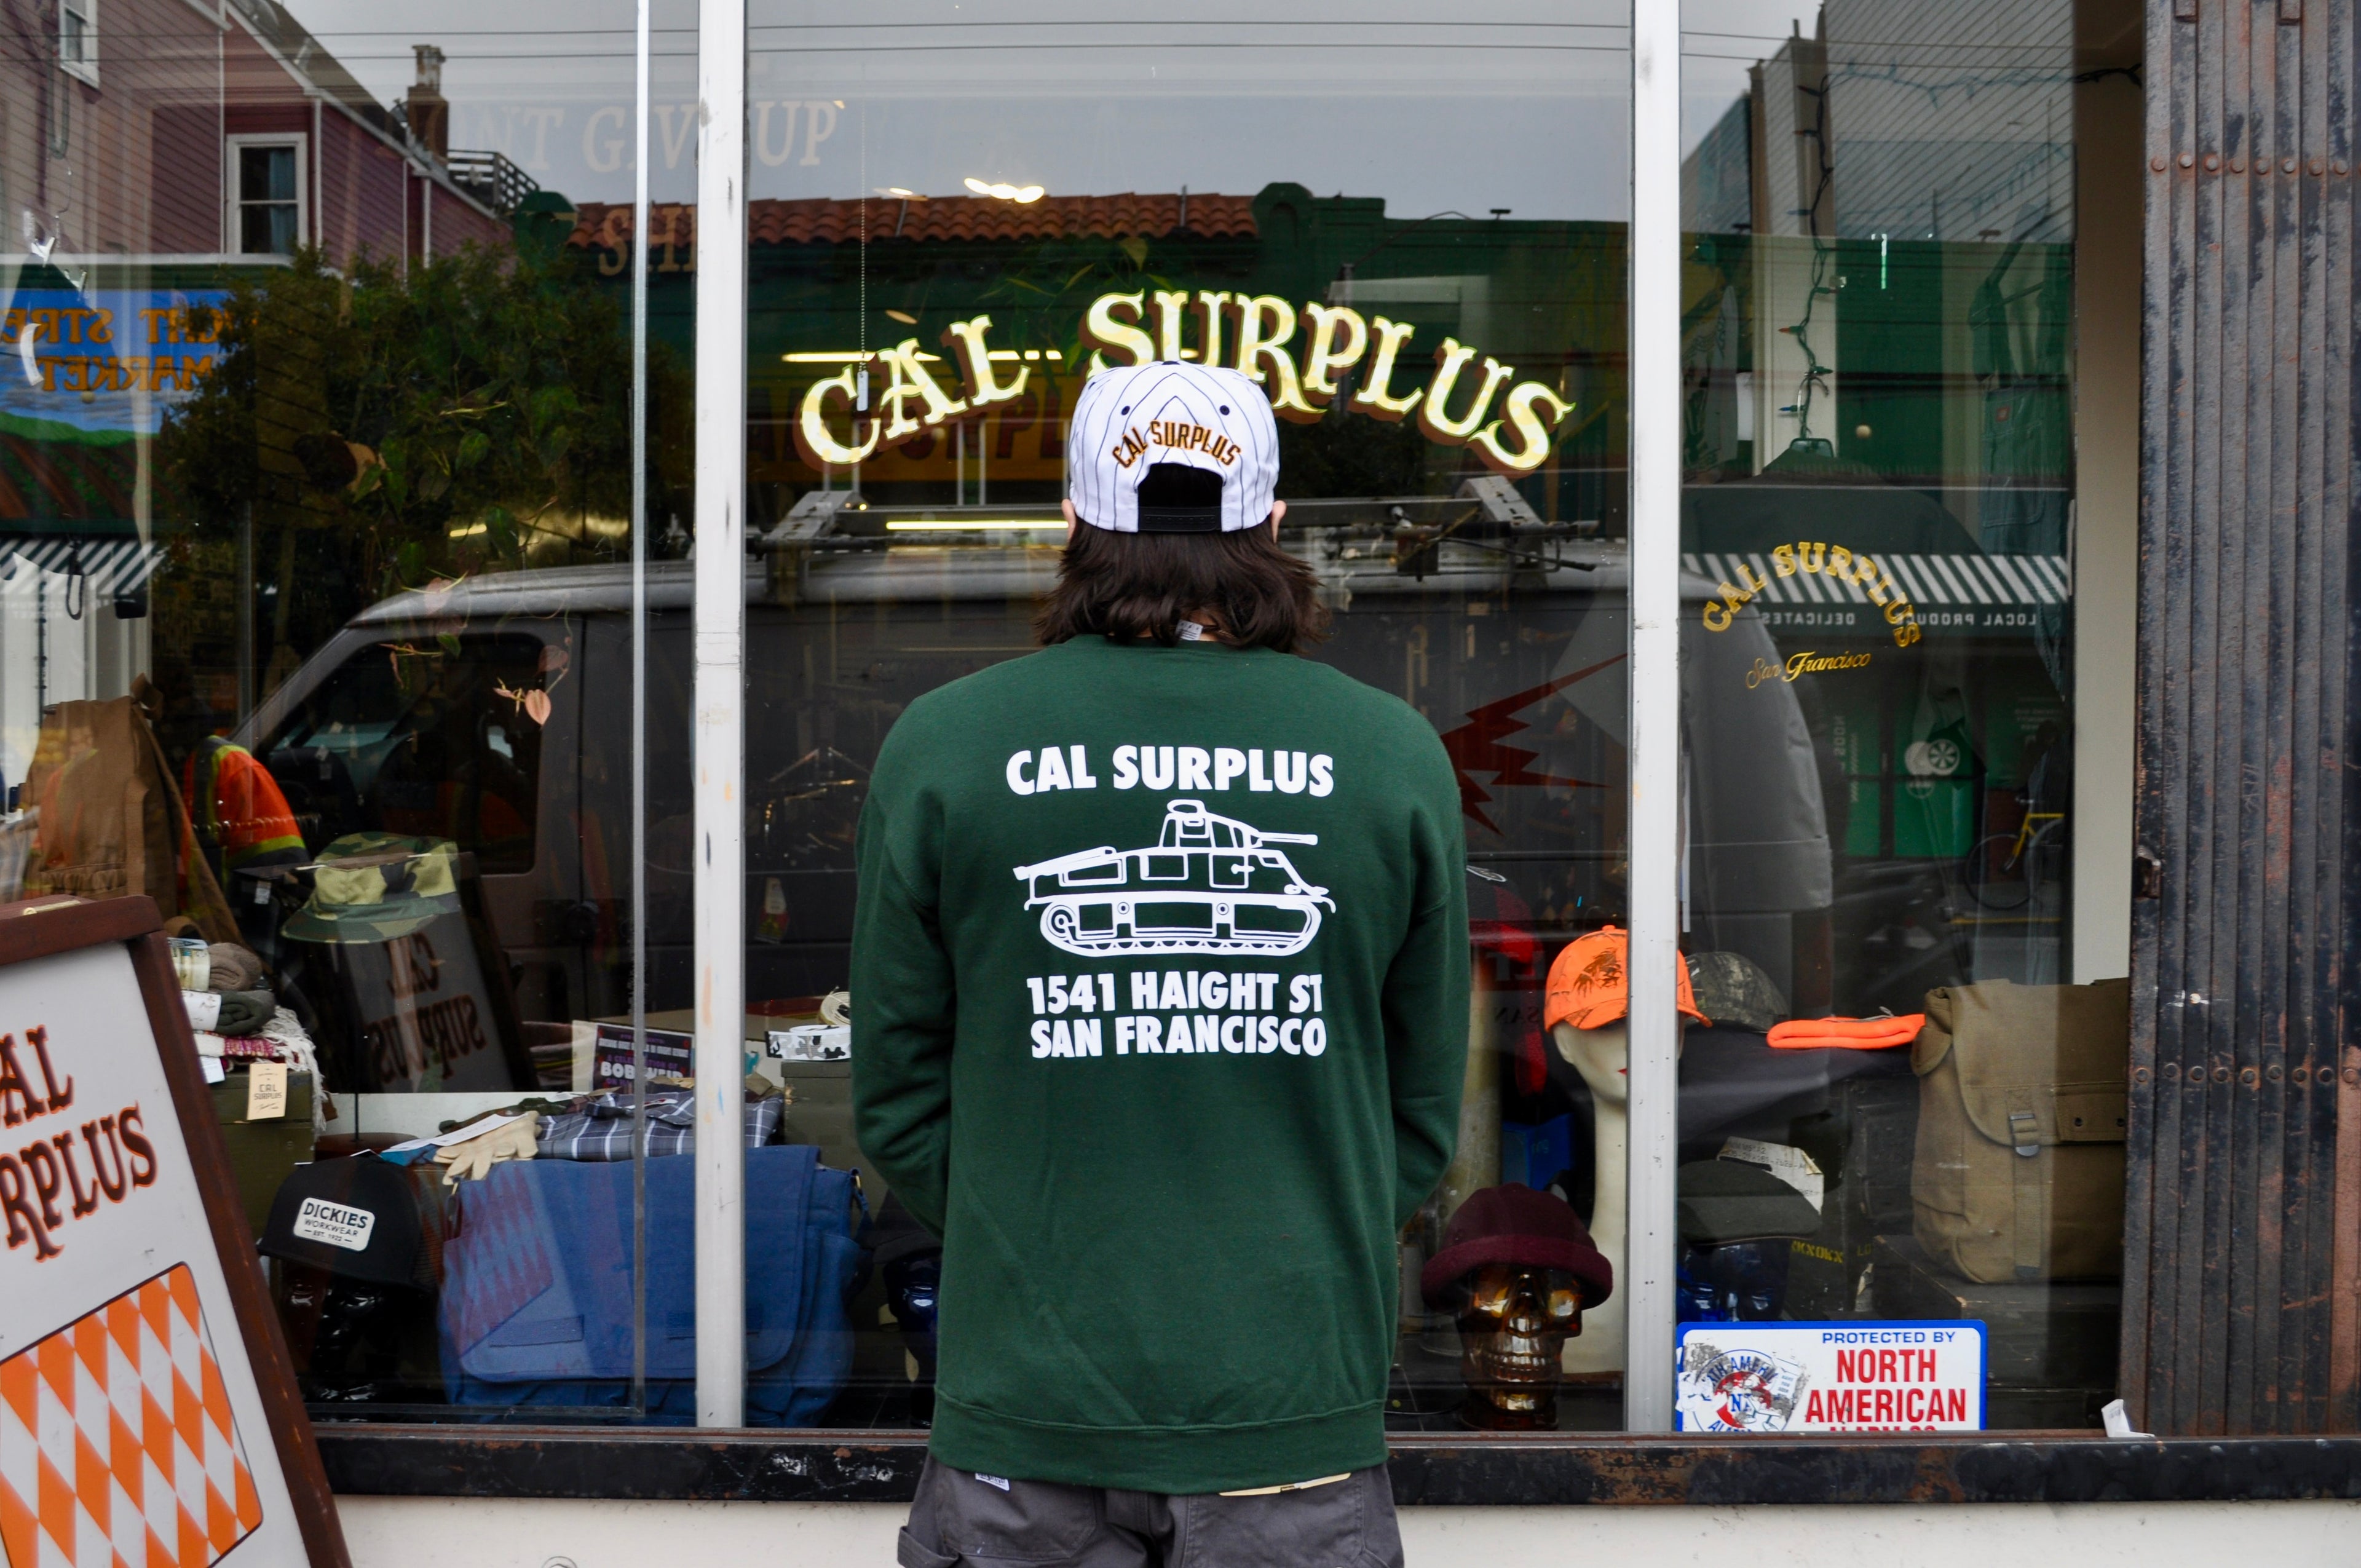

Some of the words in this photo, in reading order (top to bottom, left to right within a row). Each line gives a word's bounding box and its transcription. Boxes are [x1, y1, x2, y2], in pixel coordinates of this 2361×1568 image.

[756, 100, 837, 167] UP
[798, 314, 1030, 470] CAL
[1083, 289, 1576, 473] SURPLUS
[1112, 427, 1148, 469] CAL
[1150, 420, 1242, 466] SURPLUS
[1702, 564, 1768, 632] CAL
[1773, 542, 1921, 647] SURPLUS
[1746, 658, 1781, 688] San
[1782, 651, 1871, 682] Francisco
[1006, 745, 1096, 795] CAL
[1113, 745, 1334, 797] SURPLUS
[1027, 973, 1116, 1014] 1541
[1131, 971, 1279, 1010] HAIGHT
[1289, 974, 1323, 1013] ST
[1030, 1018, 1102, 1058] SAN
[1115, 1015, 1327, 1056] FRANCISCO
[600, 1061, 636, 1080] BOB
[304, 1202, 368, 1229] DICKIES
[304, 1219, 358, 1237] WORKWEAR
[1822, 1332, 1926, 1344] PROTECTED
[1934, 1331, 1956, 1344] BY
[1837, 1349, 1936, 1384] NORTH
[1805, 1388, 1966, 1423] AMERICAN
